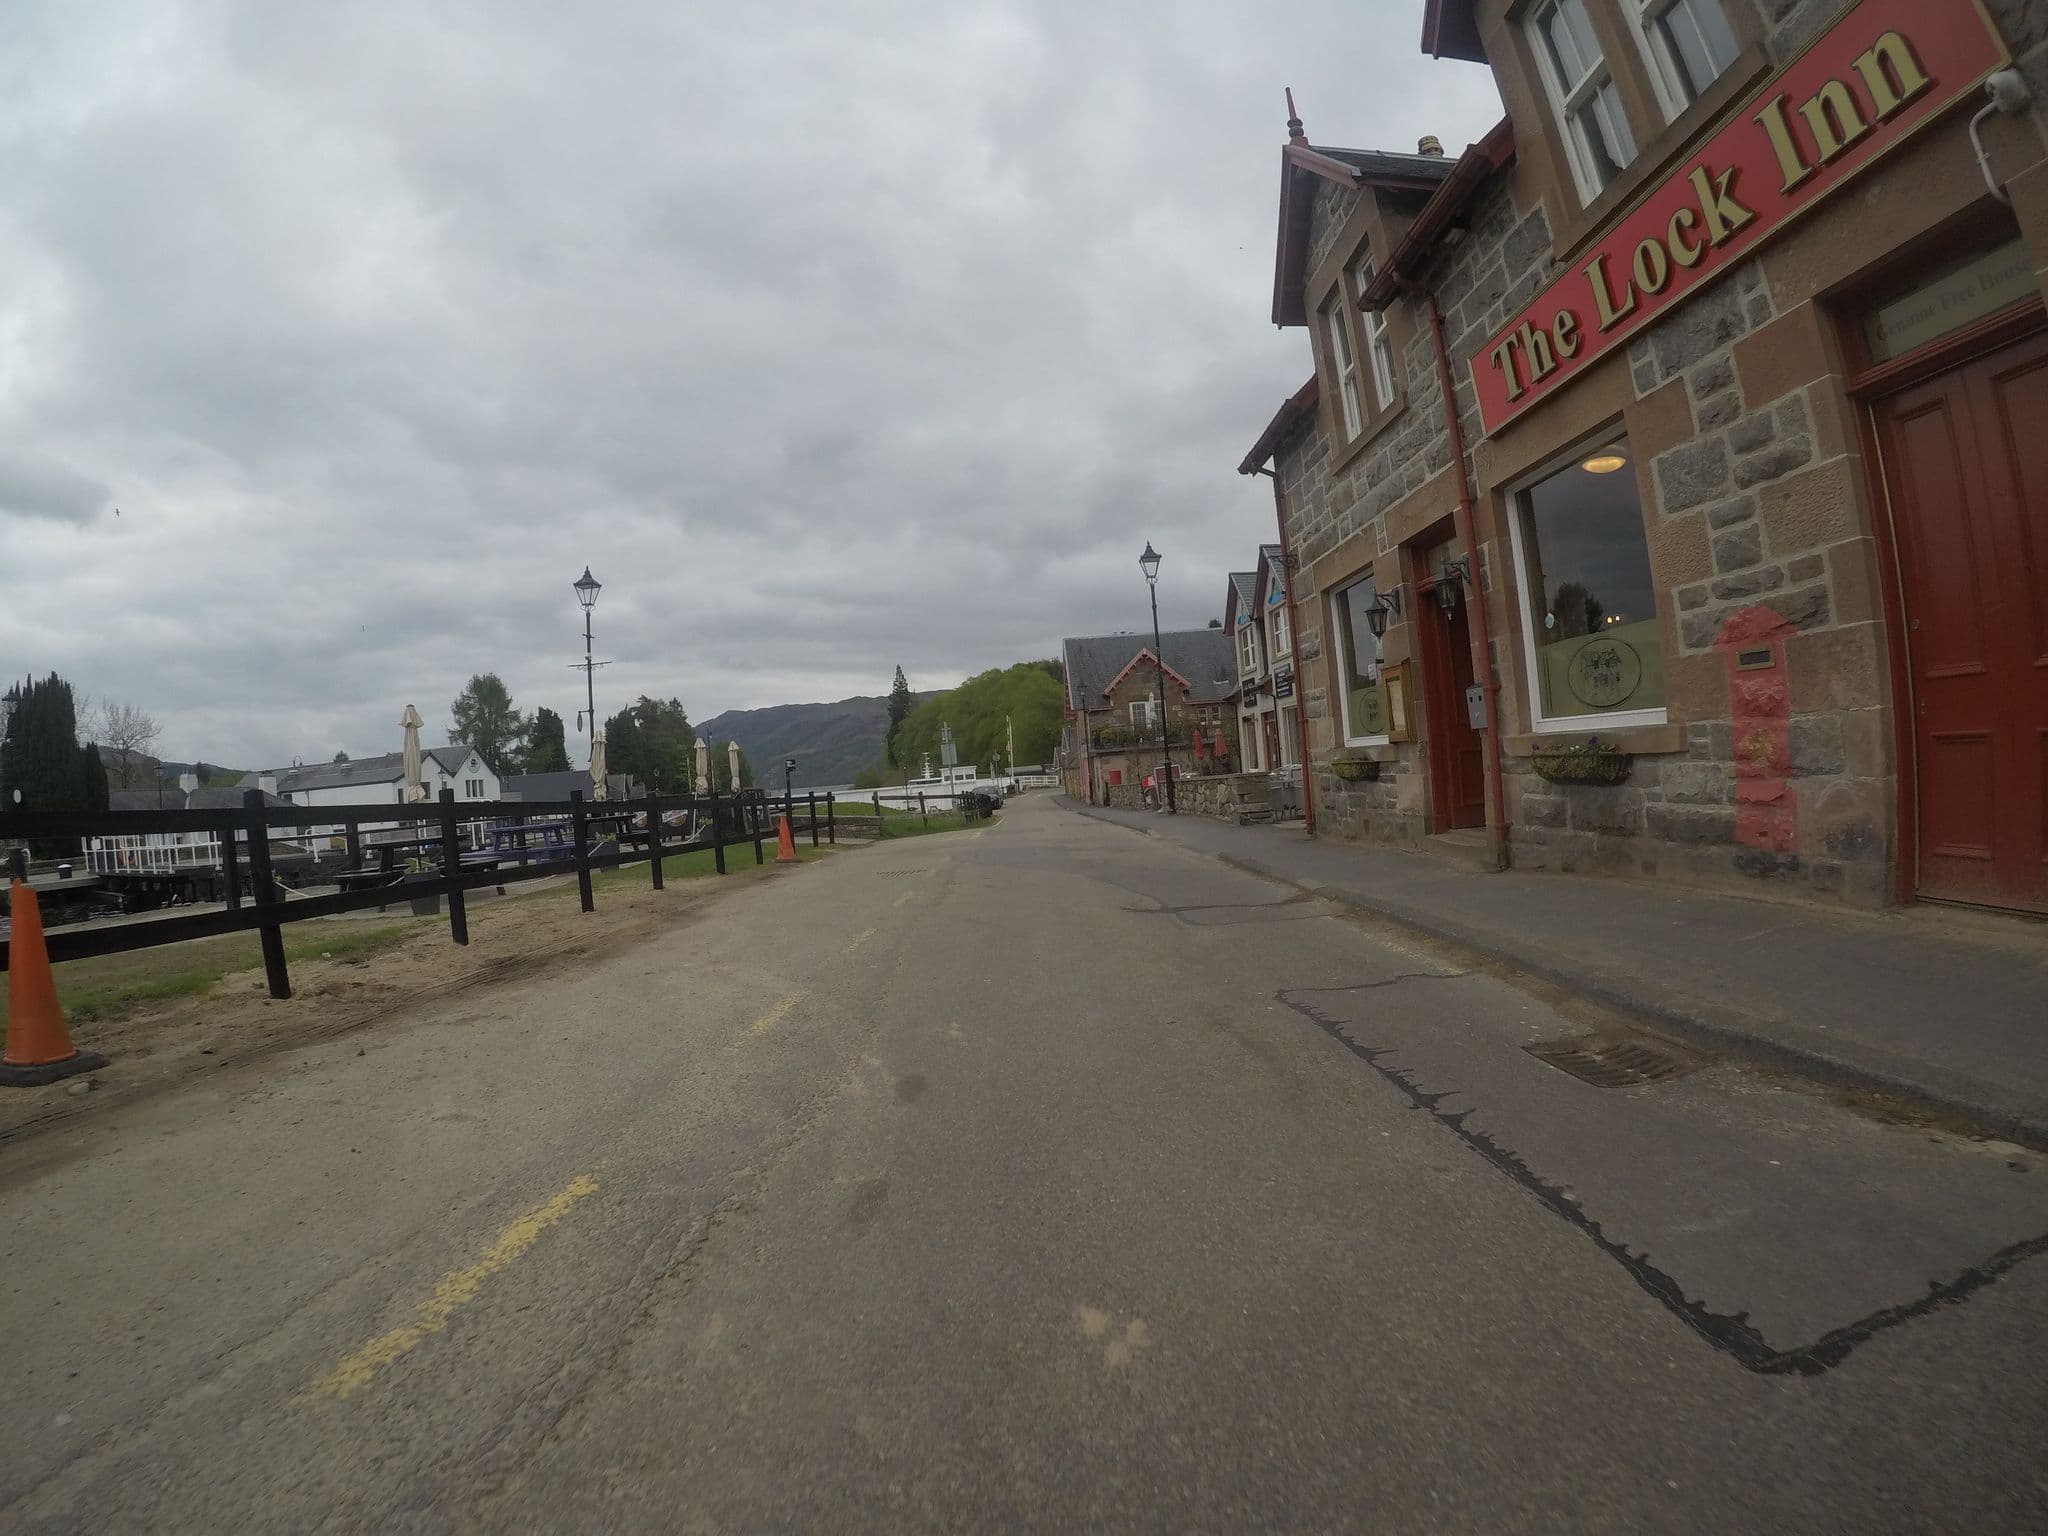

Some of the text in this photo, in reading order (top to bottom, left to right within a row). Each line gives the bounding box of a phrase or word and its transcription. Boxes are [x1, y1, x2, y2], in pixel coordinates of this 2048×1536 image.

[1490, 31, 1930, 402] The Lock Inn
